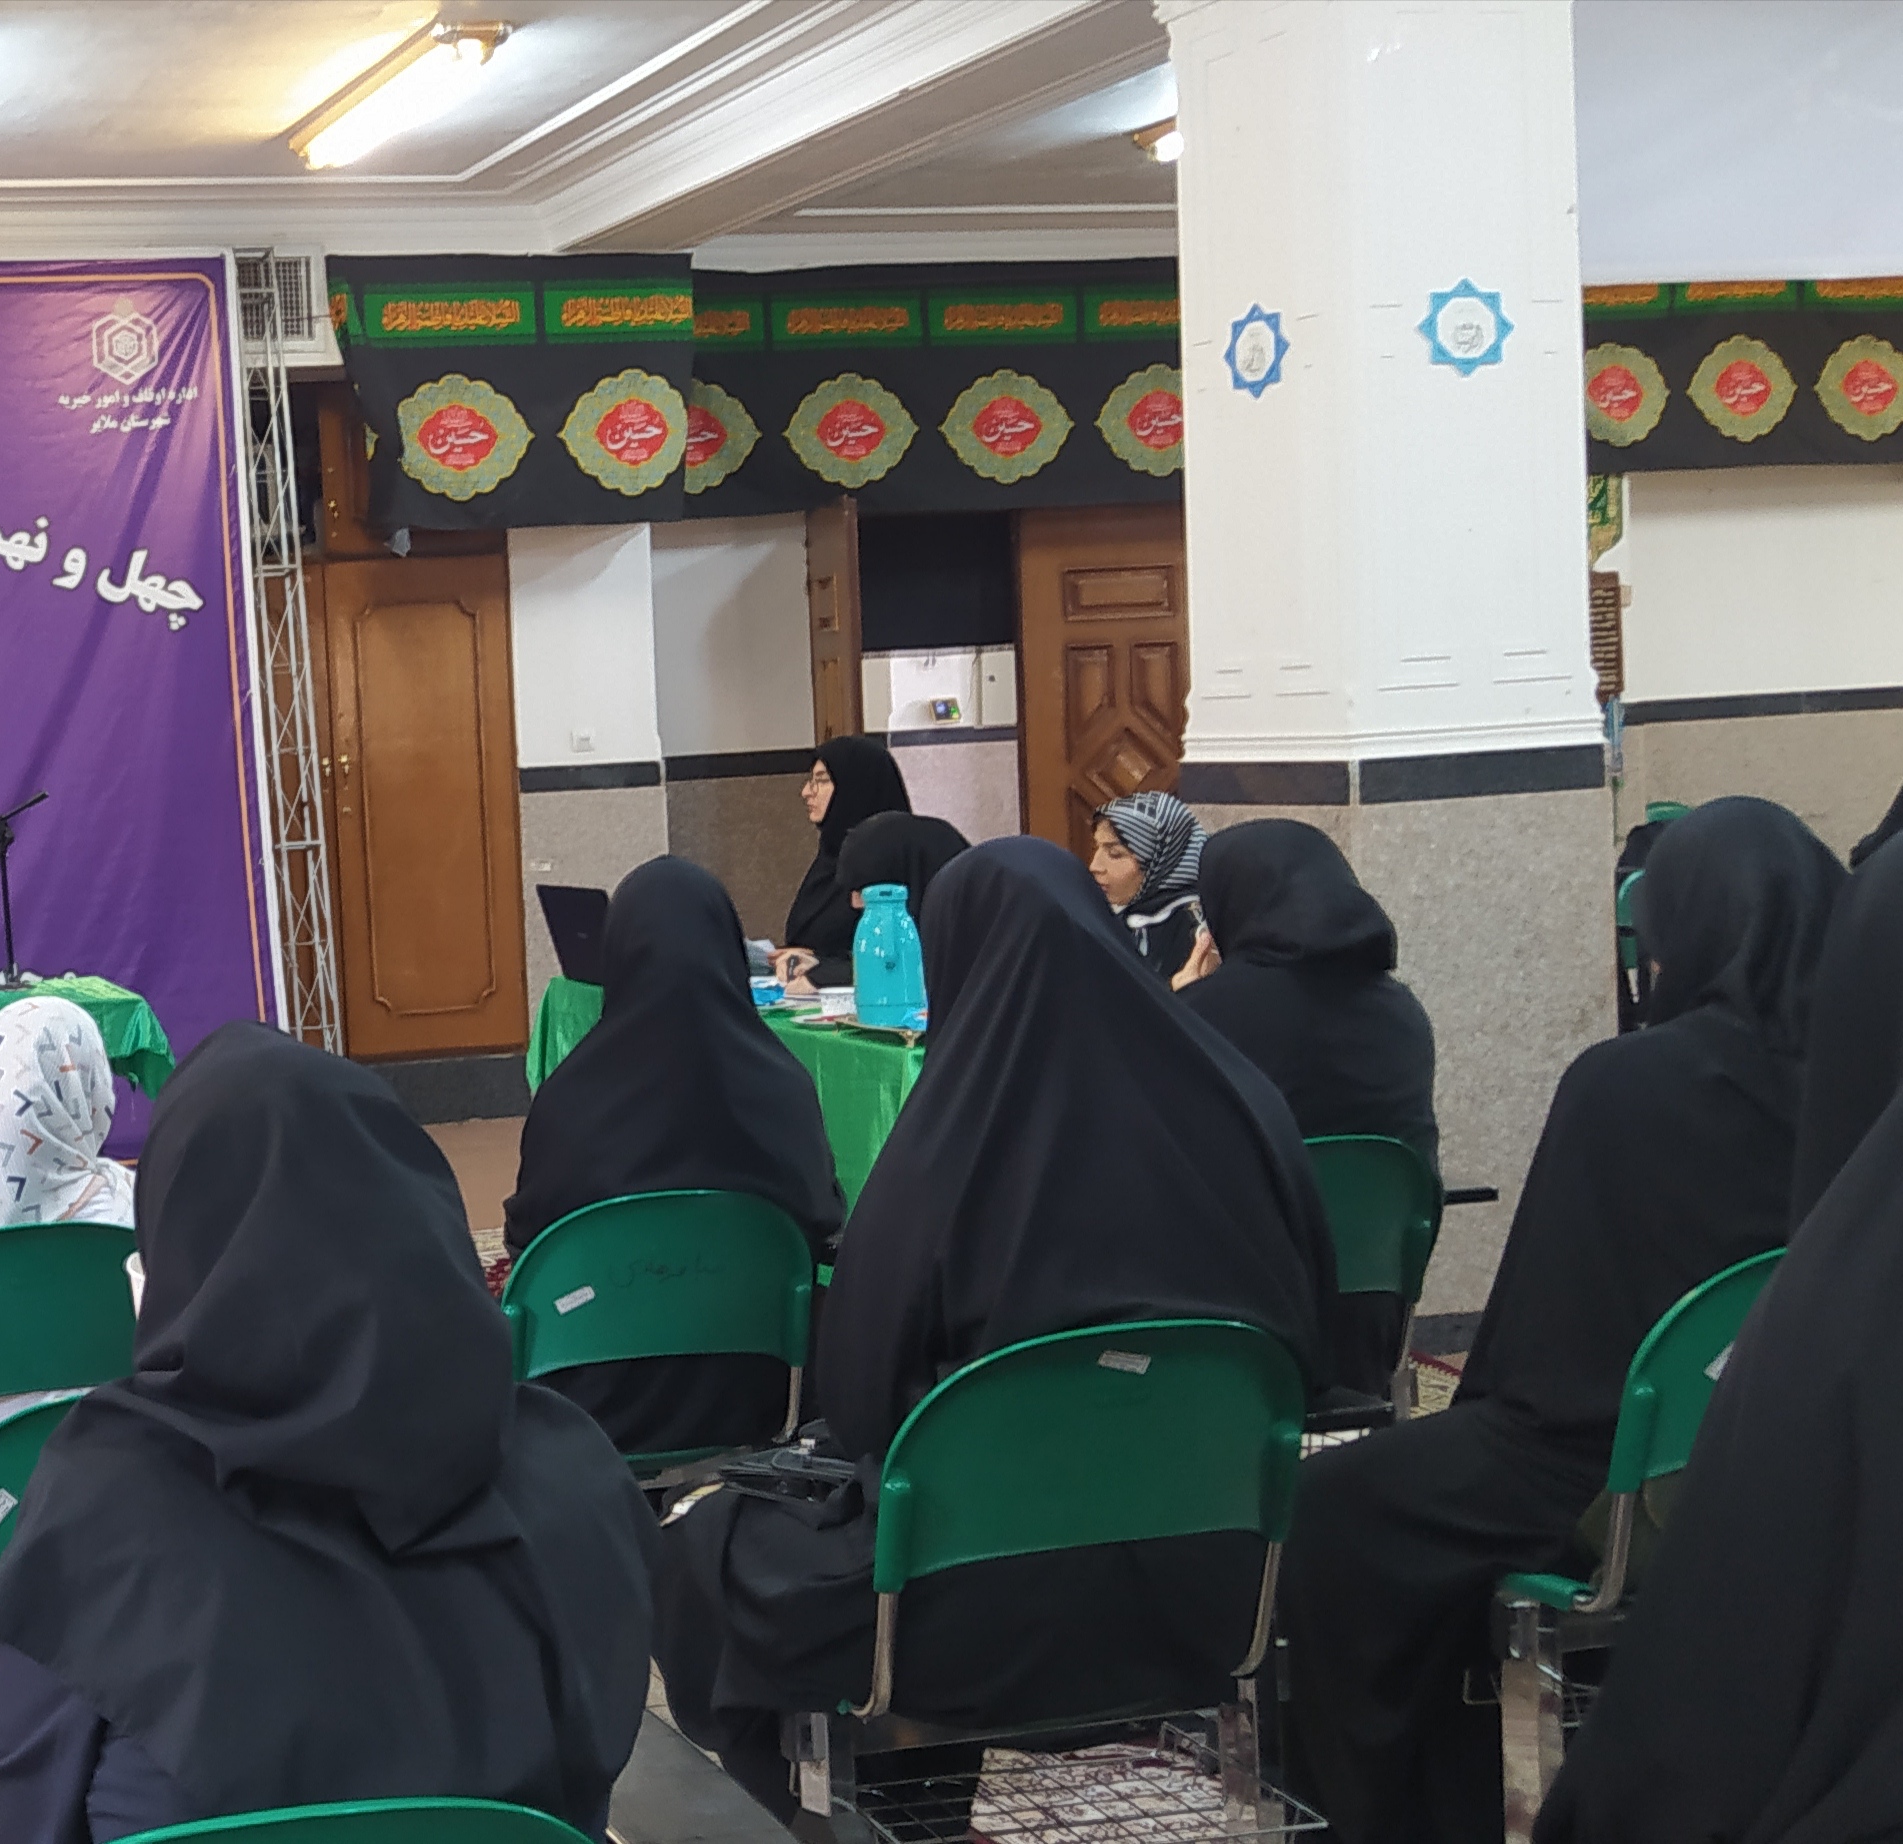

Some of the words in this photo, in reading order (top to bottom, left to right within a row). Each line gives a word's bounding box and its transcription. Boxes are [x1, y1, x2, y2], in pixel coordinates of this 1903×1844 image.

[427, 429, 489, 455] حسین
[52, 547, 87, 590] و
[97, 548, 204, 632] چهل
